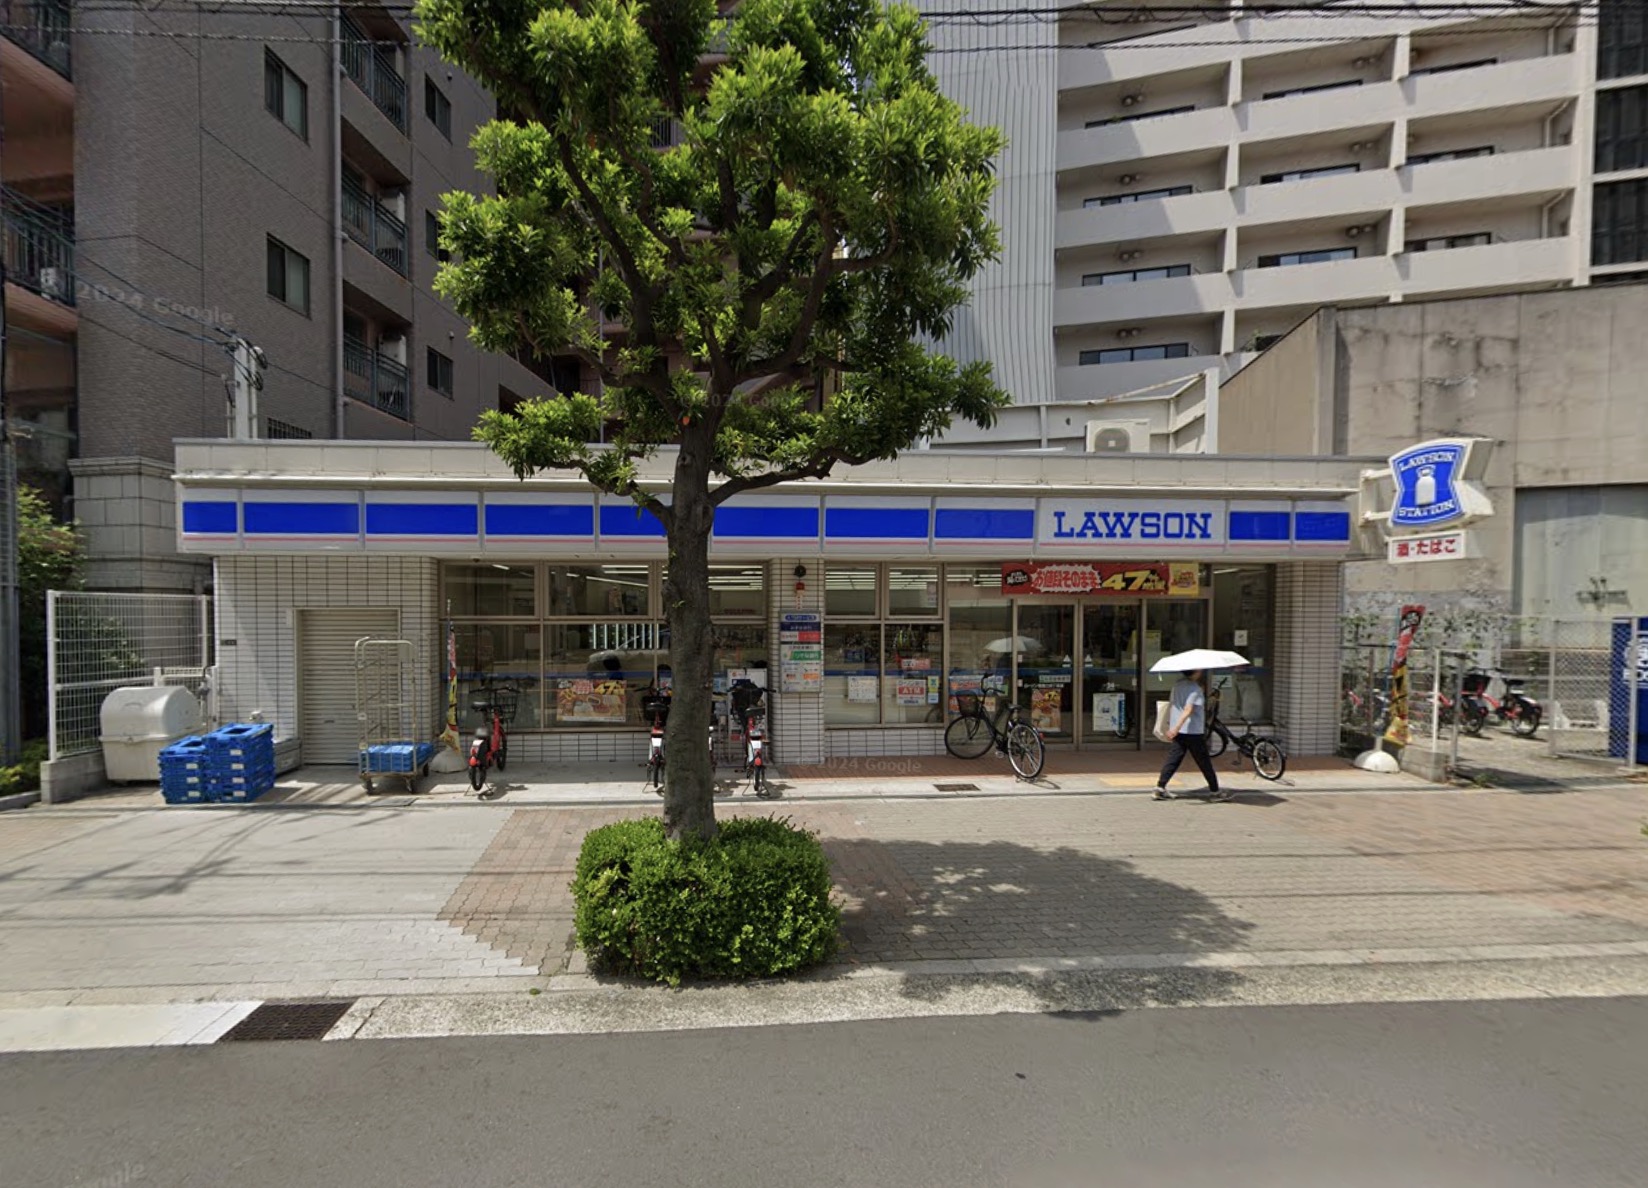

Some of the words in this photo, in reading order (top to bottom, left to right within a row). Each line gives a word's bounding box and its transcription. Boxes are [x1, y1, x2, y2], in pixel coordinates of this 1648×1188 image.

[1399, 452, 1455, 470] LAWSON
[1399, 500, 1455, 516] STATION
[1053, 511, 1212, 538] LAWSON
[902, 686, 921, 695] ATM
